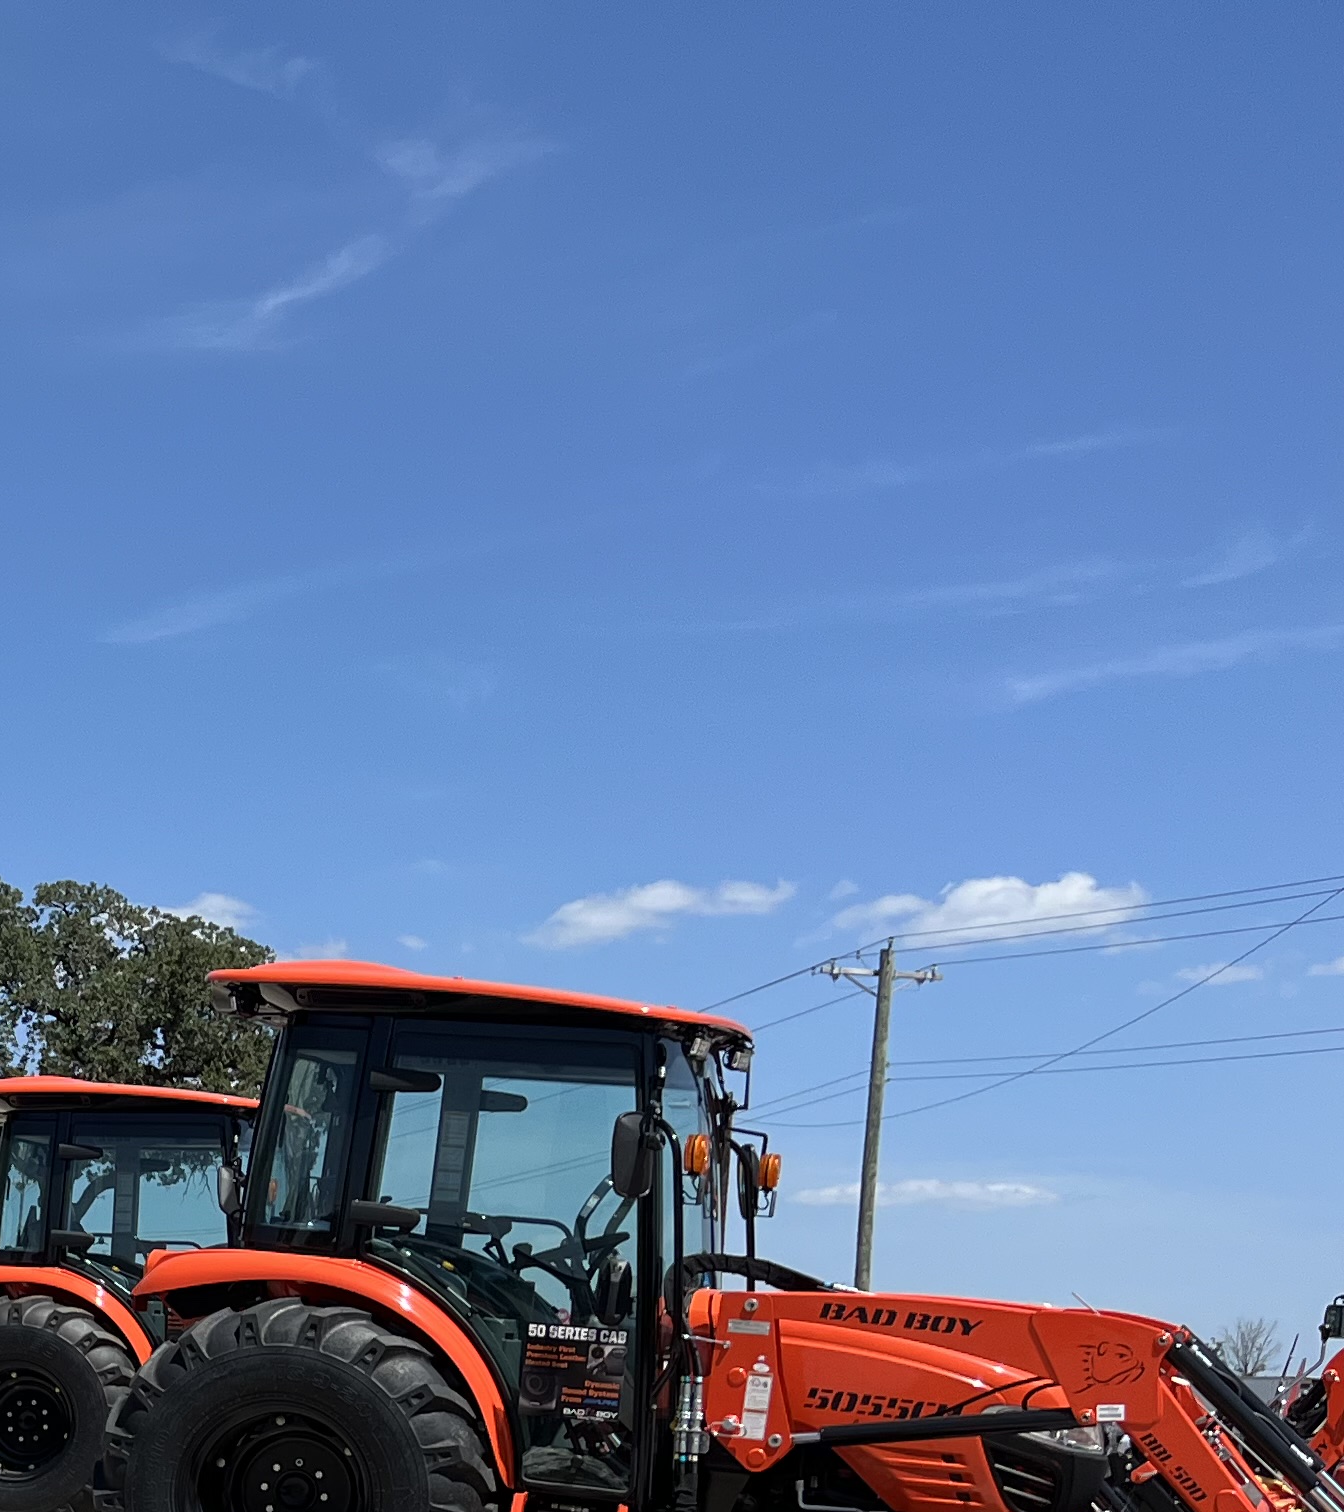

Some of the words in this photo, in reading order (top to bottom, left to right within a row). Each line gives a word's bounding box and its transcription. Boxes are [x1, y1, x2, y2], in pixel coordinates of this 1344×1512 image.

[819, 1303, 898, 1327] BAD
[903, 1311, 985, 1337] BOY
[528, 1323, 546, 1338] 50
[549, 1325, 596, 1341] SERIES
[600, 1330, 628, 1344] CAB
[562, 1407, 586, 1417] BAD
[595, 1410, 619, 1420] BOY
